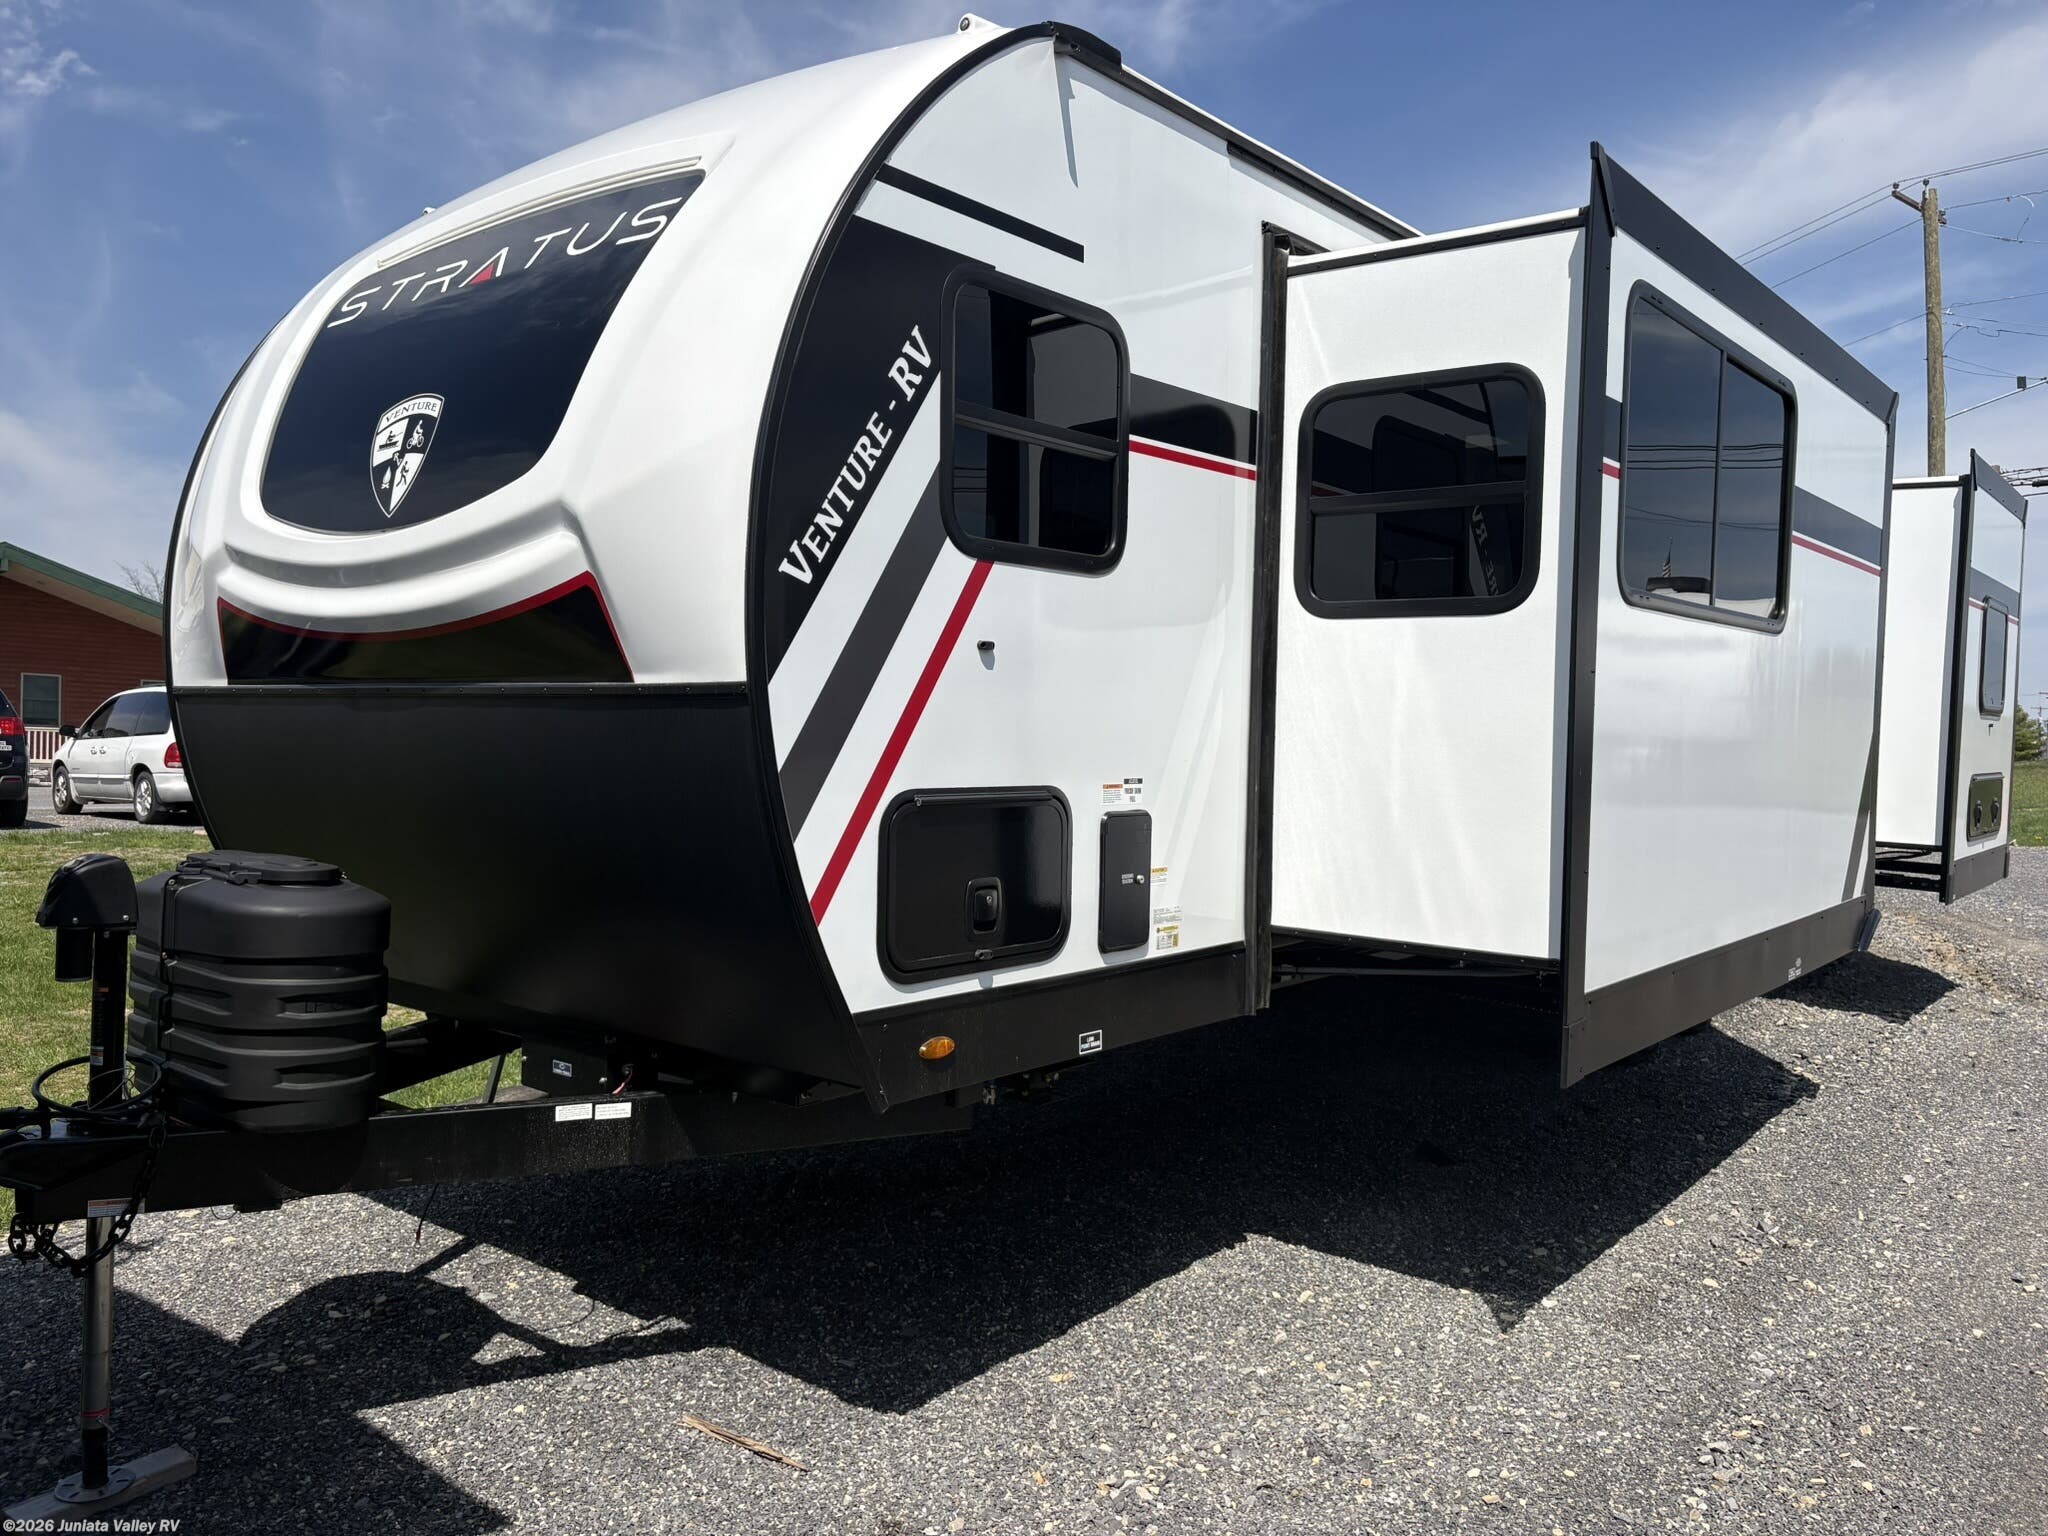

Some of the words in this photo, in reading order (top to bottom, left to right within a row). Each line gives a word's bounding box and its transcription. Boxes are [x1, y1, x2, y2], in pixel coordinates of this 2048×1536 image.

[327, 197, 682, 328] STRATUS
[386, 401, 438, 423] VENTURE
[778, 411, 893, 584] VENTURE
[888, 324, 932, 402] RV
